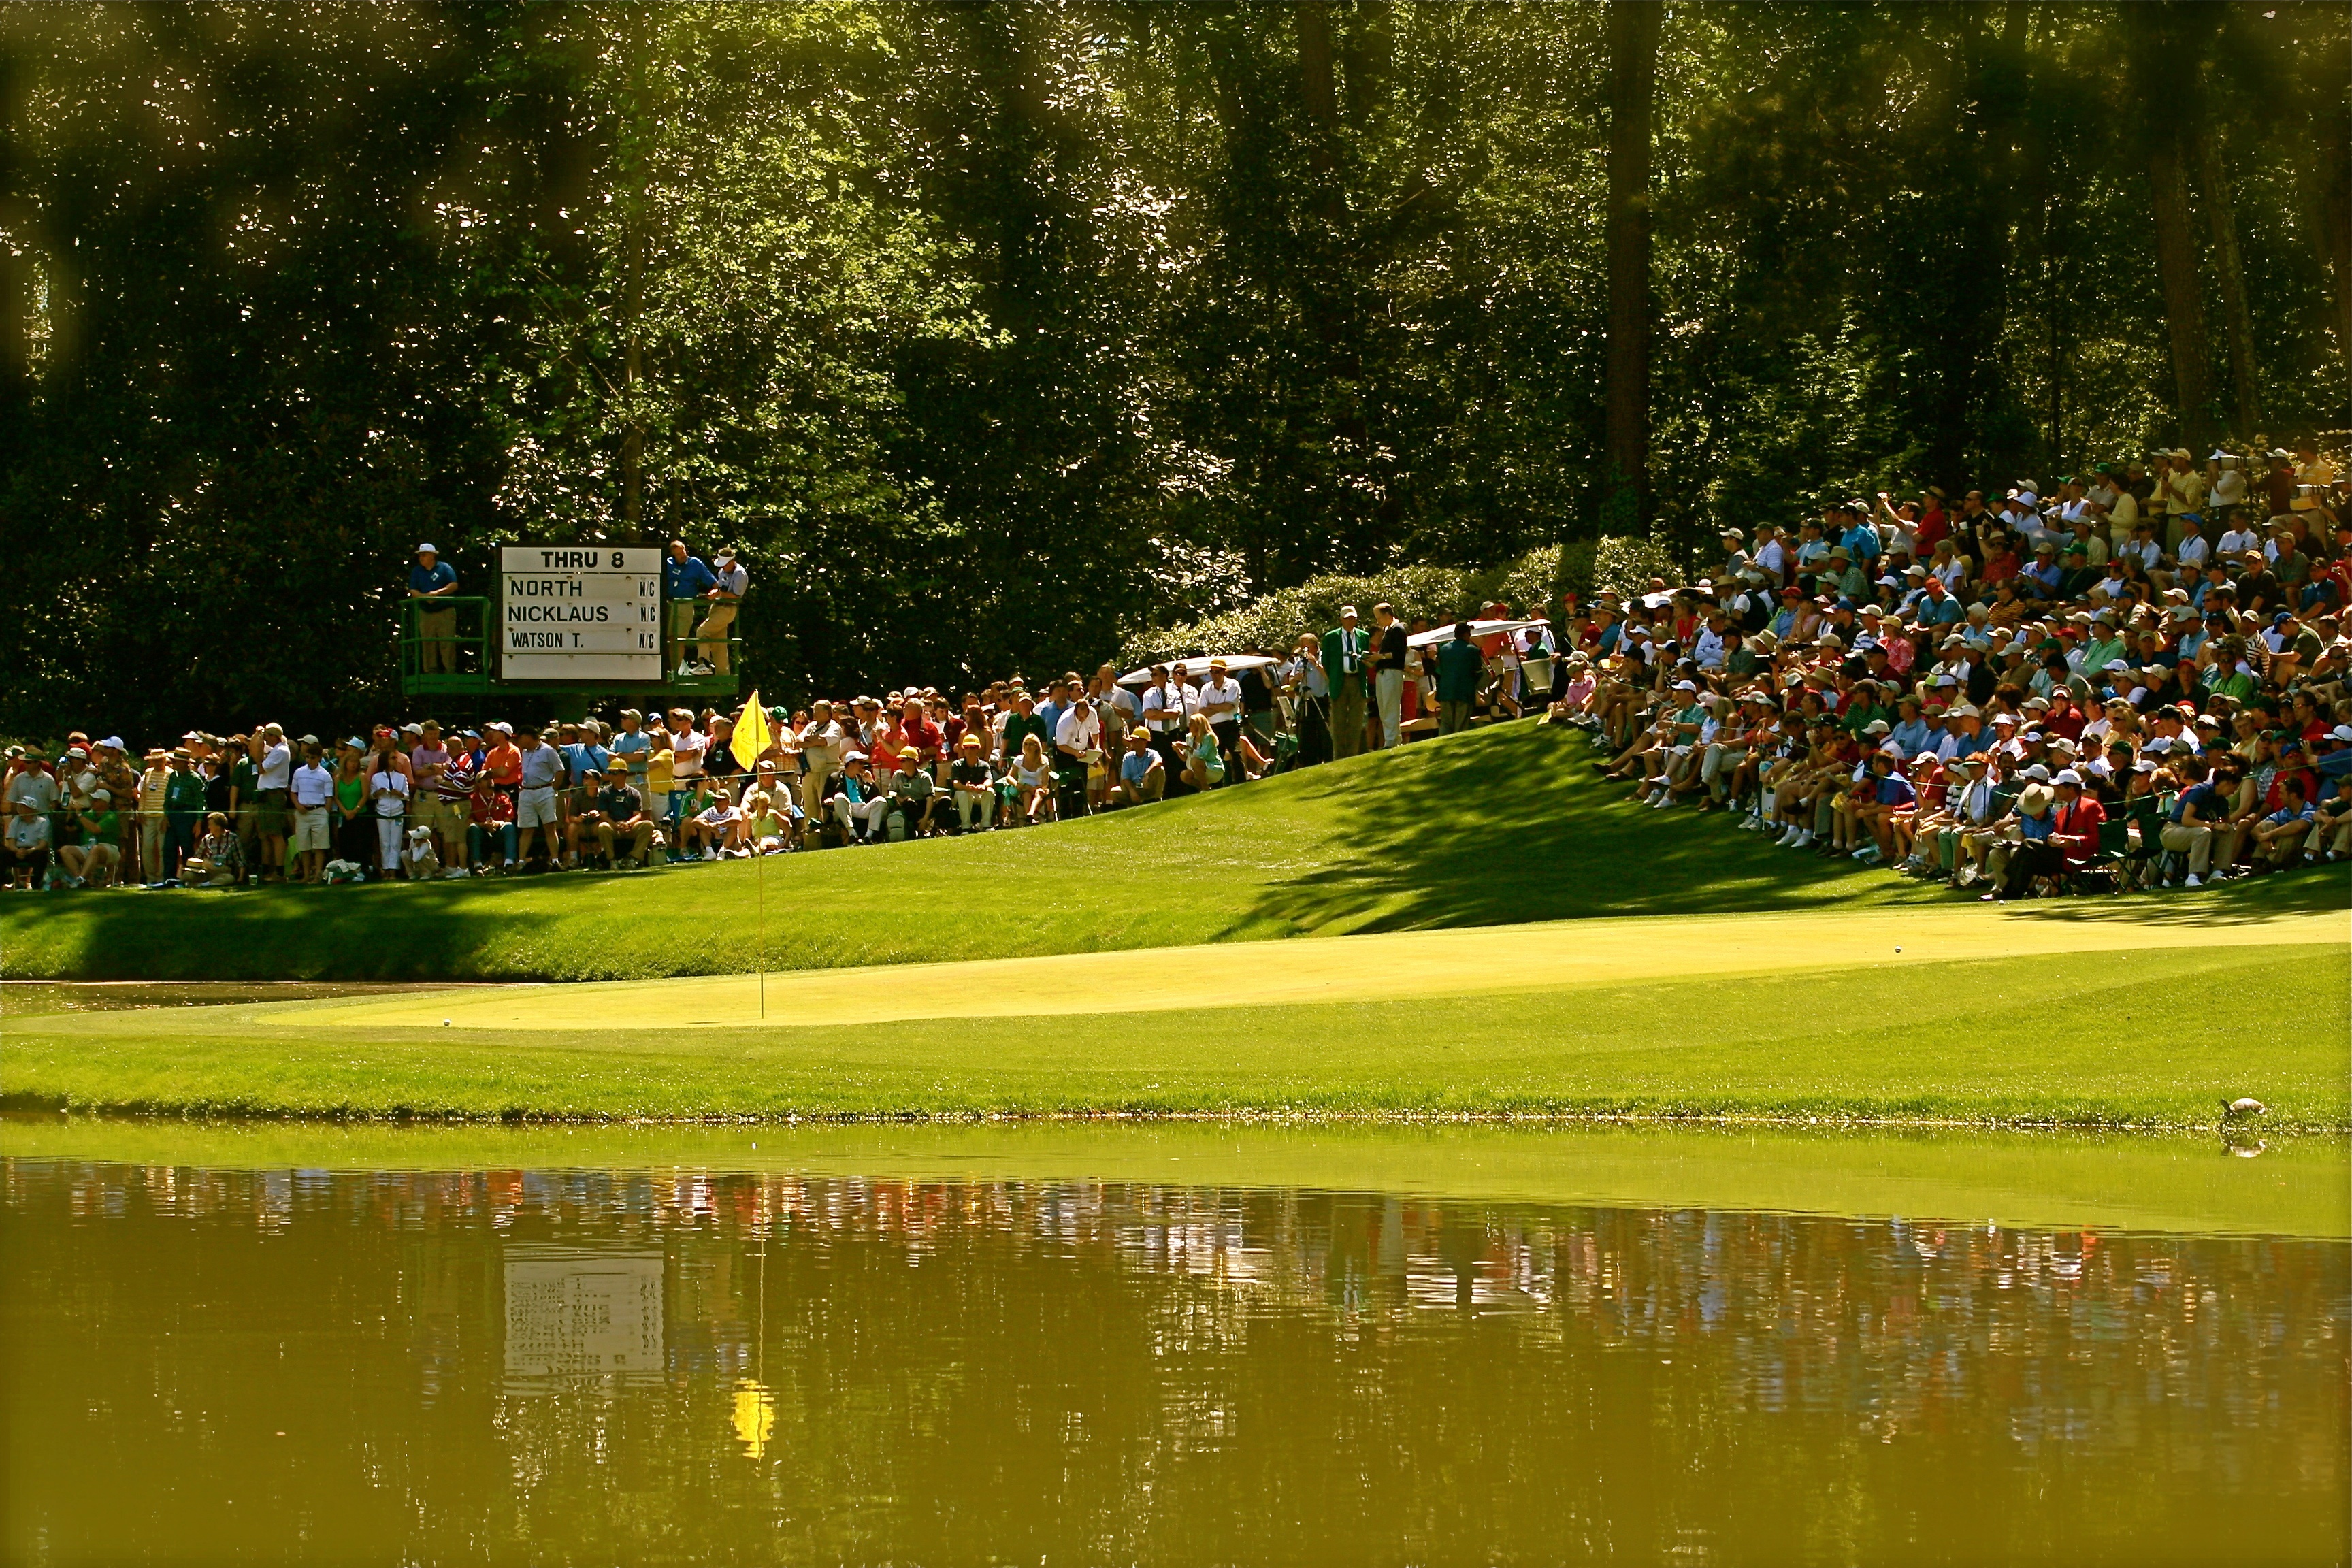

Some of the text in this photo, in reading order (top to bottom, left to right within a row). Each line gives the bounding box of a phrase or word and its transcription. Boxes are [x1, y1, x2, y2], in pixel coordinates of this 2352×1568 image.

[541, 552, 624, 568] THRU 8
[511, 581, 582, 596] NORTH
[640, 581, 655, 597] N/C
[508, 606, 608, 622] NICKLAUS
[640, 607, 655, 623] N/C
[512, 633, 583, 648] WATSON T.
[639, 634, 654, 649] N/C
